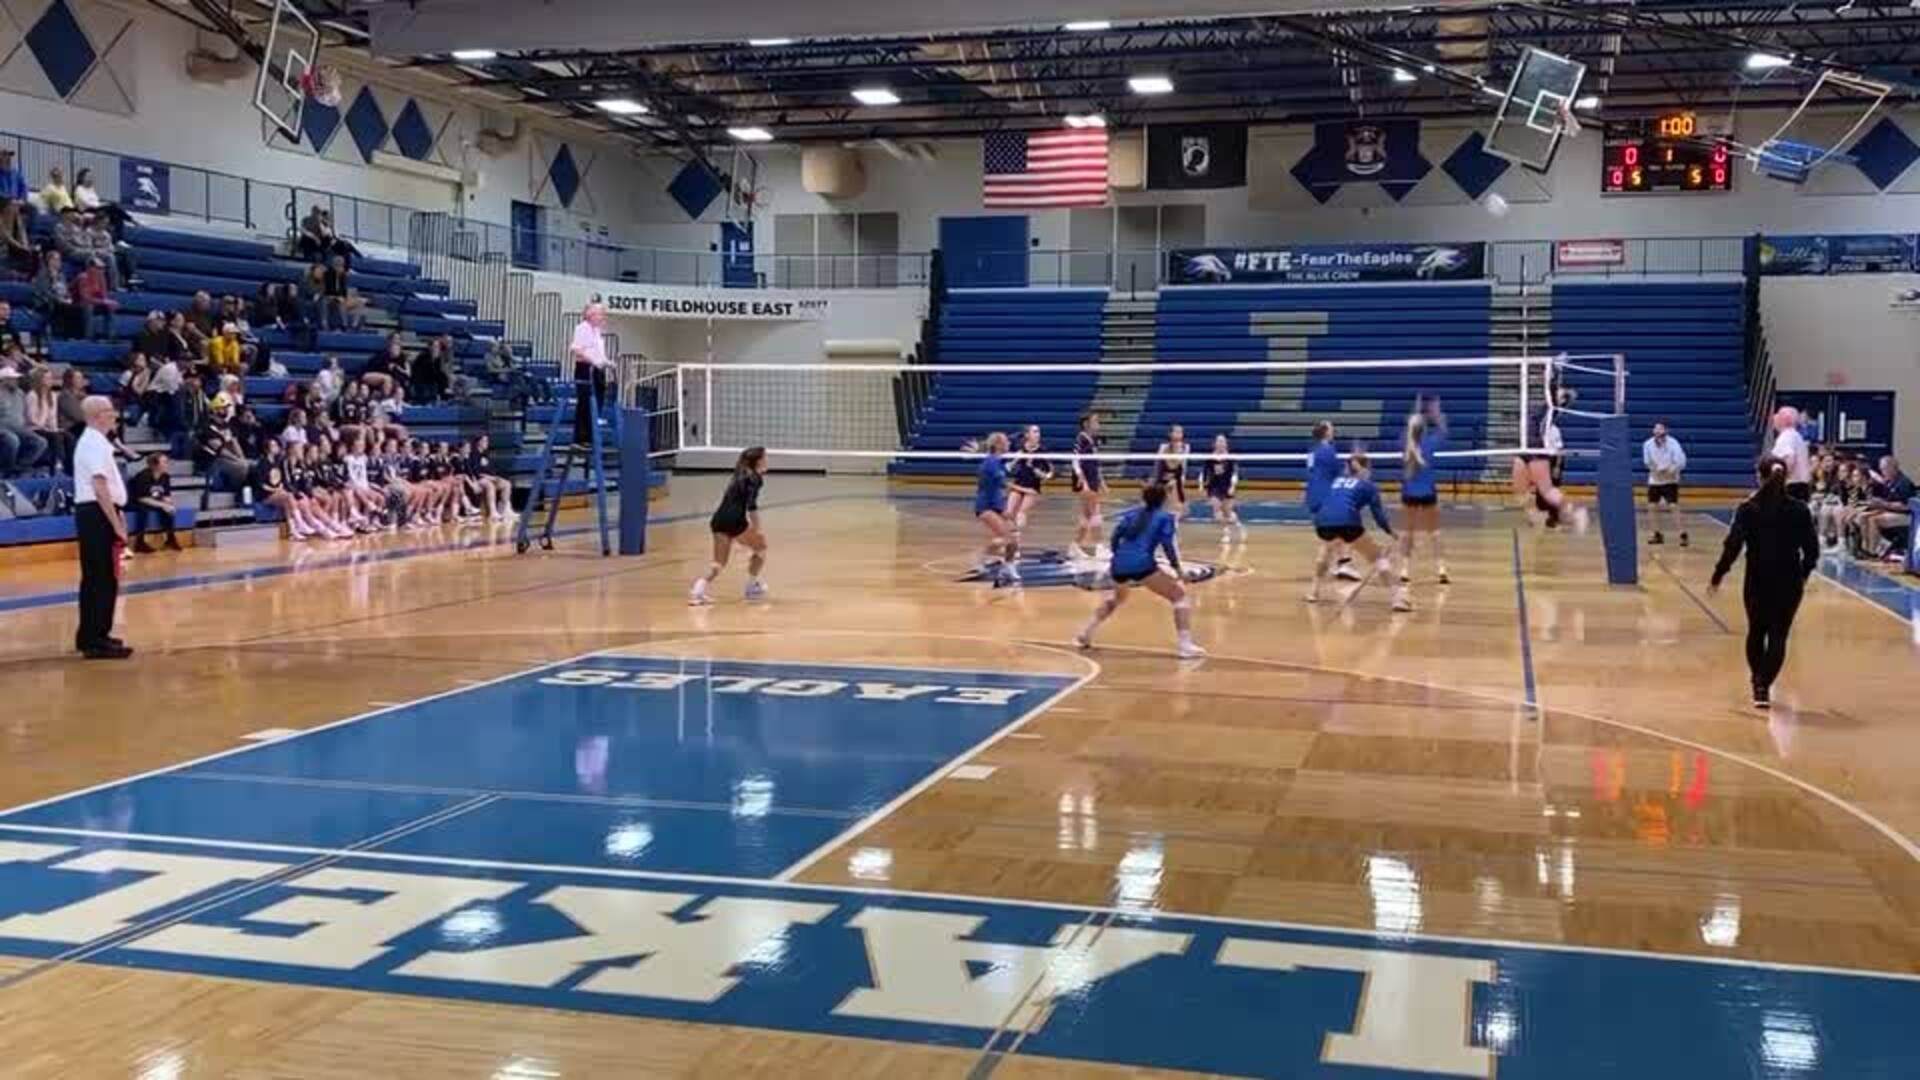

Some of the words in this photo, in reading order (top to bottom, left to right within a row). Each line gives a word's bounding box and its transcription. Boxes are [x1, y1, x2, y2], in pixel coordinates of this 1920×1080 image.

[1625, 147, 1638, 165] 0
[1286, 272, 1304, 280] THE
[608, 296, 646, 310] SZOTT
[651, 299, 747, 314] FIELDHOUSE
[752, 302, 793, 315] EAST
[539, 669, 1027, 705] EAGLES
